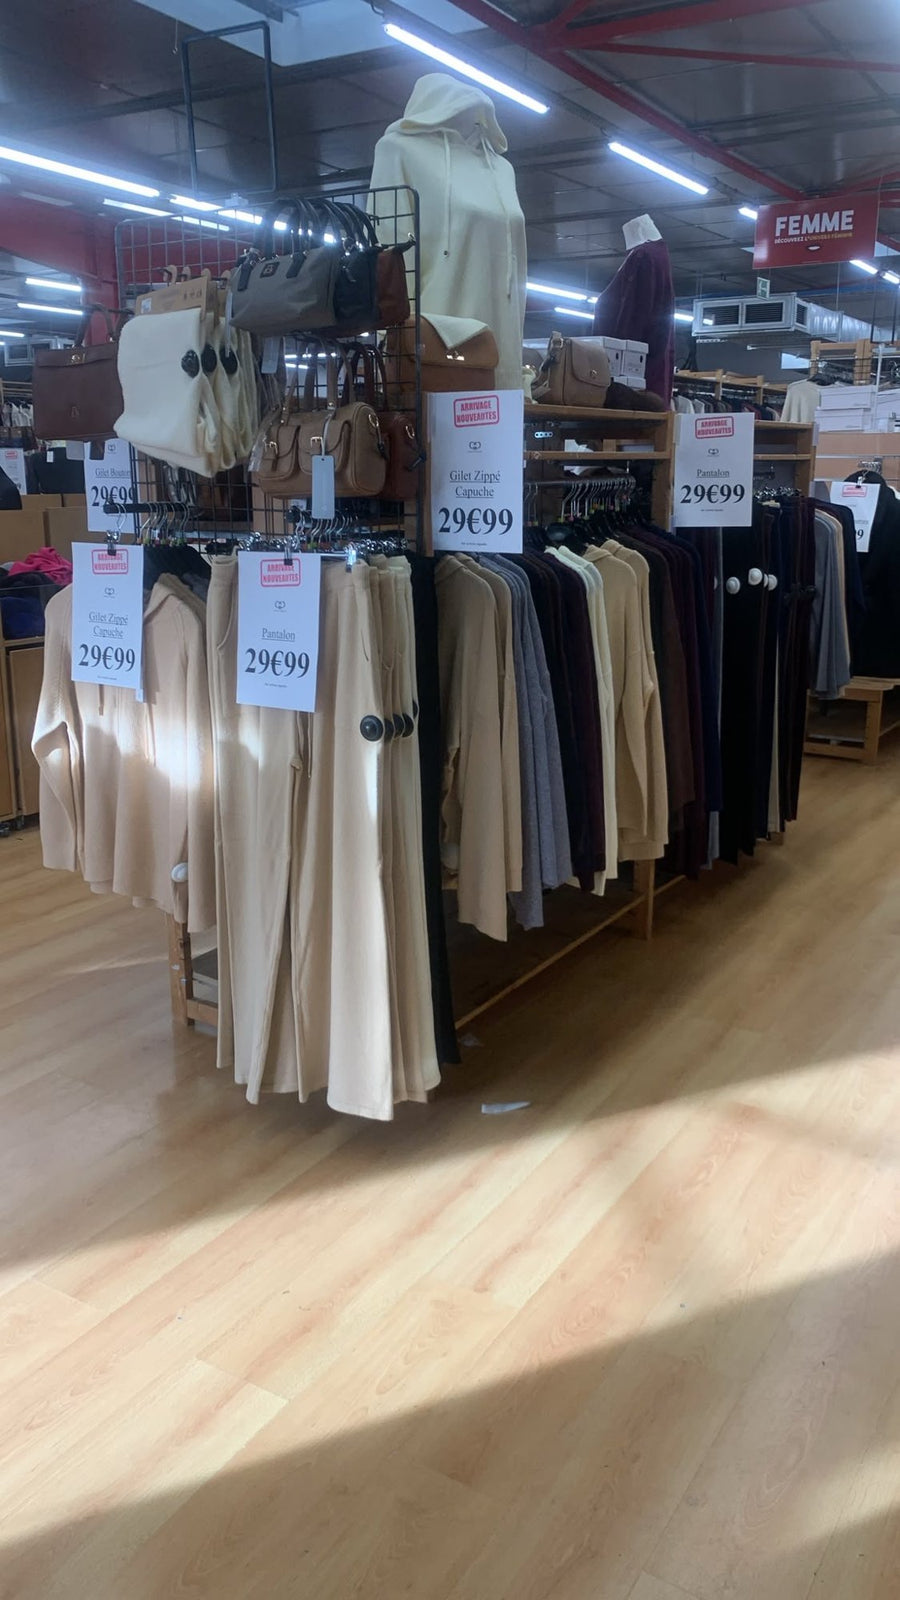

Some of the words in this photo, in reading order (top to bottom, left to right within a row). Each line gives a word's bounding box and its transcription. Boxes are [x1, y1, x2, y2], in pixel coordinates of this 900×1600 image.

[775, 210, 855, 237] FEMME
[460, 400, 492, 412] ARRIVAGE
[456, 411, 497, 423] NOUVEAUTES
[450, 470, 471, 481] Gilet
[474, 470, 501, 484] Zippé
[696, 469, 730, 477] Pantalon
[455, 486, 495, 499] Capuche
[680, 484, 745, 504] 29€99
[438, 507, 514, 535] 29€99
[88, 611, 107, 622] Gilet
[108, 613, 129, 625] Zippé
[93, 626, 124, 638] Capuche
[262, 628, 296, 641] Pantalon
[78, 643, 136, 672] 29€99
[244, 648, 310, 679] 29€99
